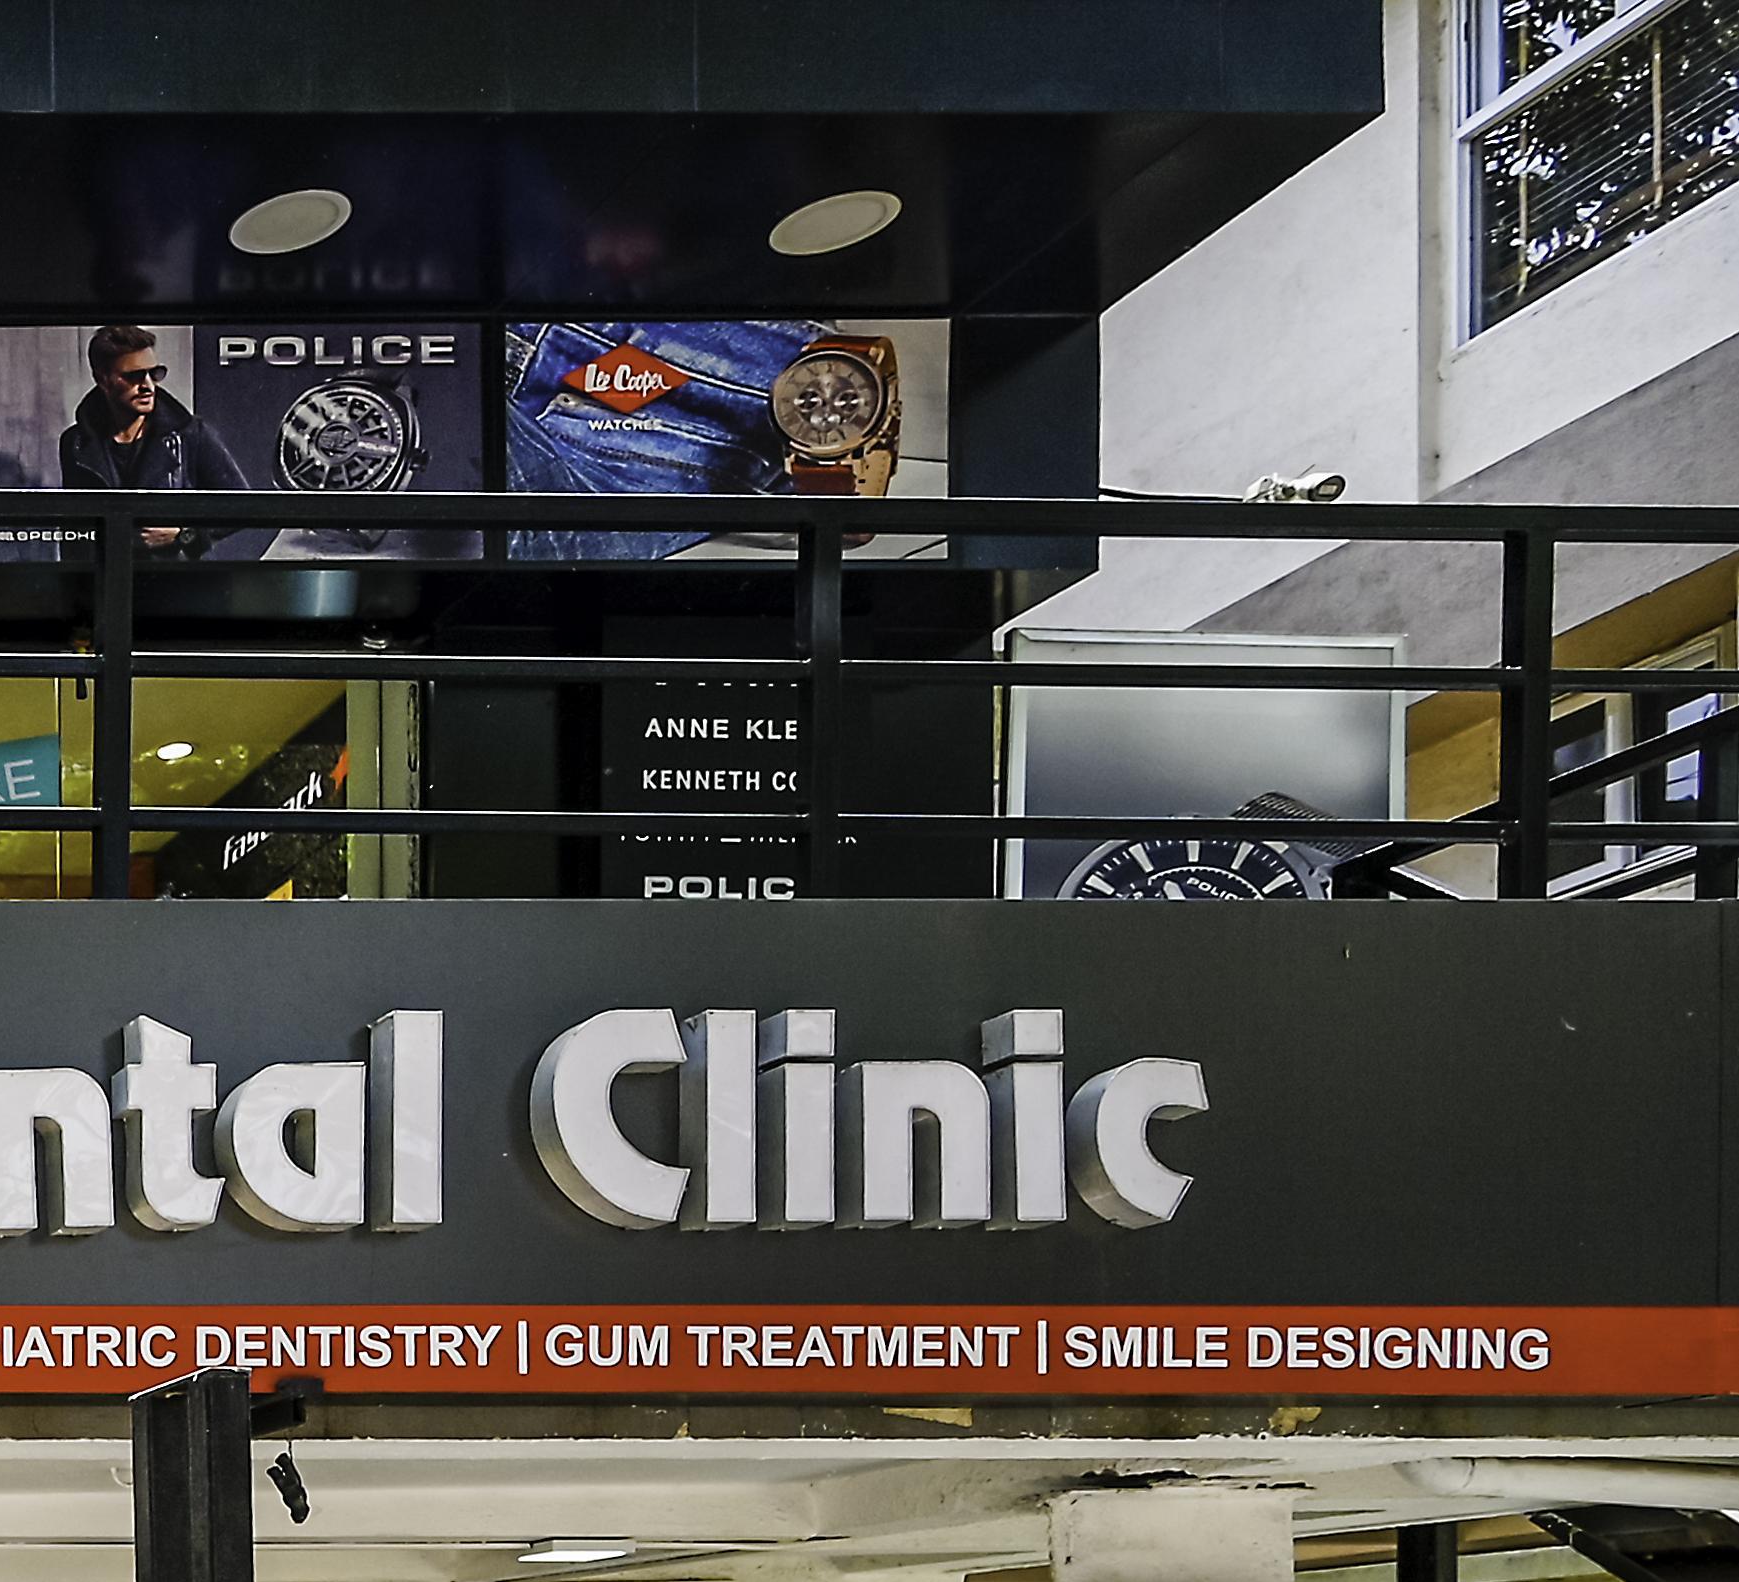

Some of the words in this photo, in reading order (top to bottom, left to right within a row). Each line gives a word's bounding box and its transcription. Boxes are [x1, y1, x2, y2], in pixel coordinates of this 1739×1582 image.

[218, 335, 455, 365] POLICE
[584, 363, 611, 392] Lee
[613, 364, 672, 398] Cooper
[587, 419, 663, 431] WATCHES
[644, 718, 730, 738] ANNE
[746, 719, 798, 740] KLE
[642, 769, 761, 791] KENNETH
[644, 876, 795, 900] POLIC
[1186, 877, 1243, 900] POLIC
[529, 1006, 1211, 1232] Clinic
[194, 1325, 502, 1367] DENTISTRY
[544, 1325, 669, 1367] GUM
[685, 1325, 1020, 1367] TREATMENT
[1063, 1325, 1228, 1367] SMILE
[1246, 1326, 1549, 1370] DESIGNING
